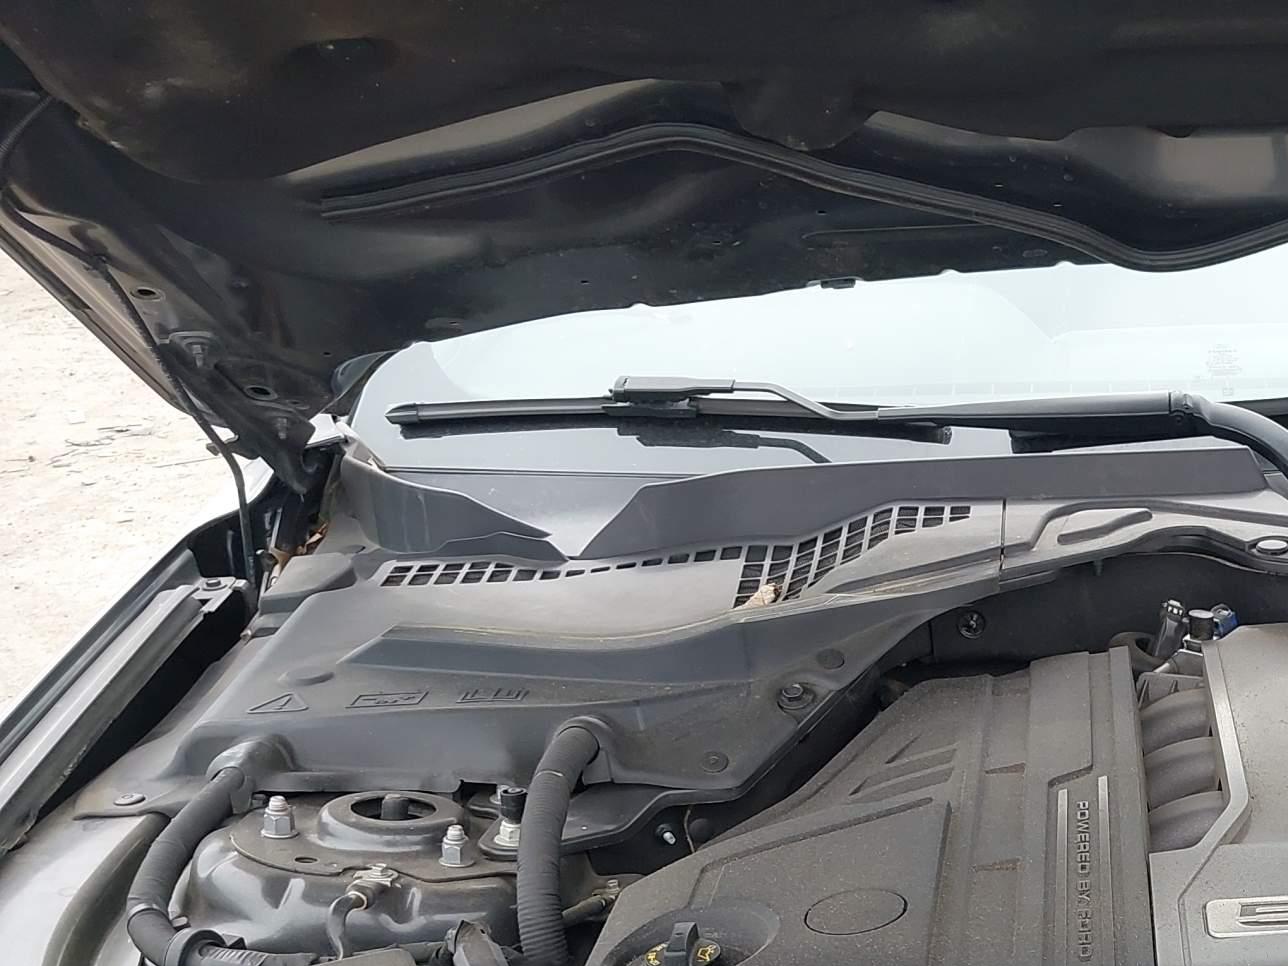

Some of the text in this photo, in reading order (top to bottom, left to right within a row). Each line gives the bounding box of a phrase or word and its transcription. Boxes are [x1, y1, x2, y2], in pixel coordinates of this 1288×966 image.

[1076, 800, 1093, 963] POWERED BY FORD
